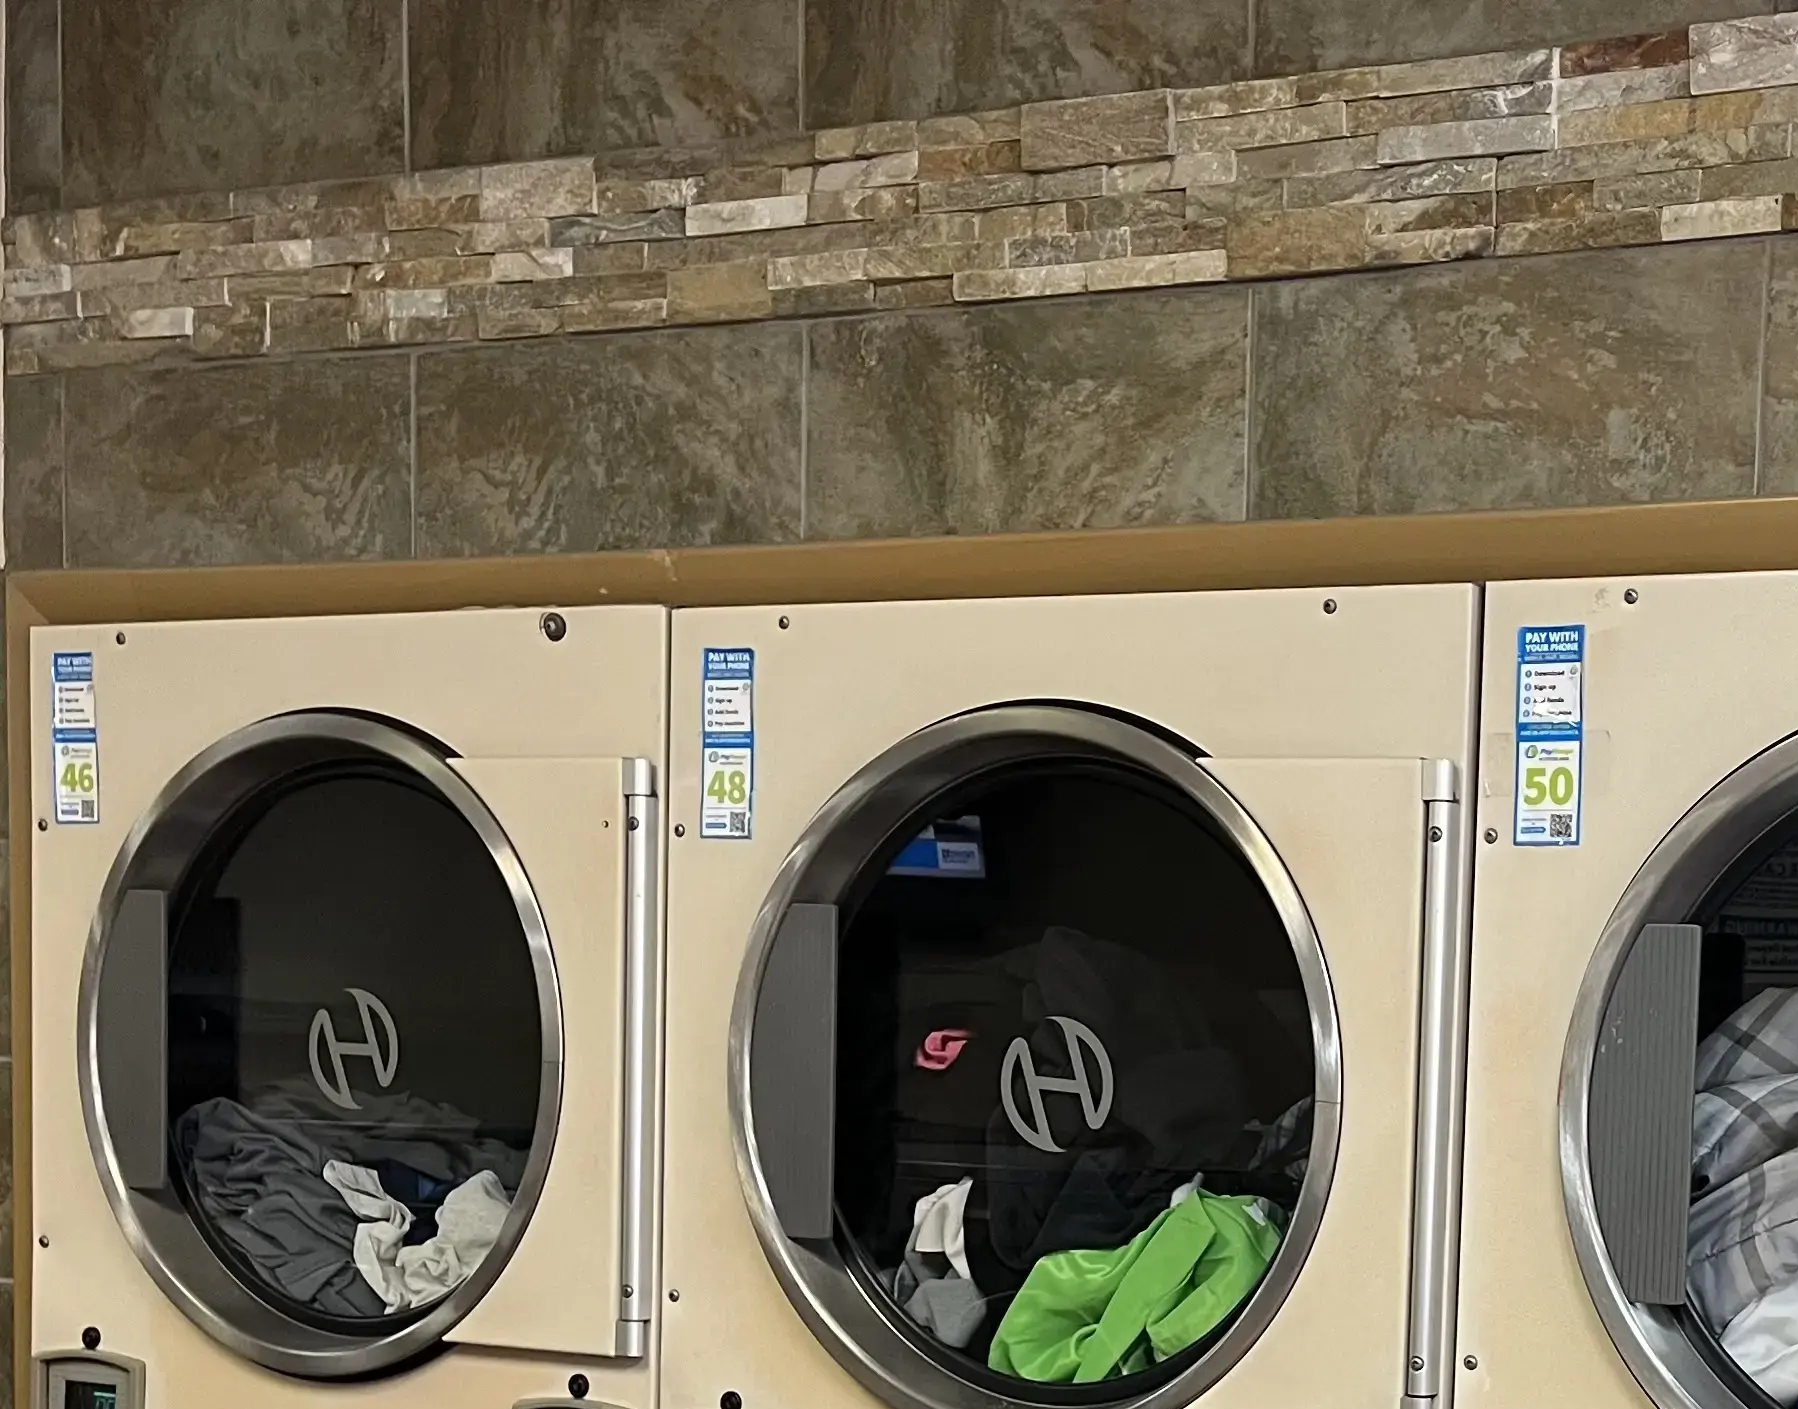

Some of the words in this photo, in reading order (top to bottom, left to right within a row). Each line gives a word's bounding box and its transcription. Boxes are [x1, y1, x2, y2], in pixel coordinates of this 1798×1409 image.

[1525, 632, 1547, 644] PAY
[1549, 631, 1578, 642] WITH
[1525, 643, 1548, 652] YOUR
[1550, 642, 1578, 652] PHONE
[60, 763, 94, 793] 46
[707, 770, 746, 804] 48
[1523, 766, 1574, 806] 50
